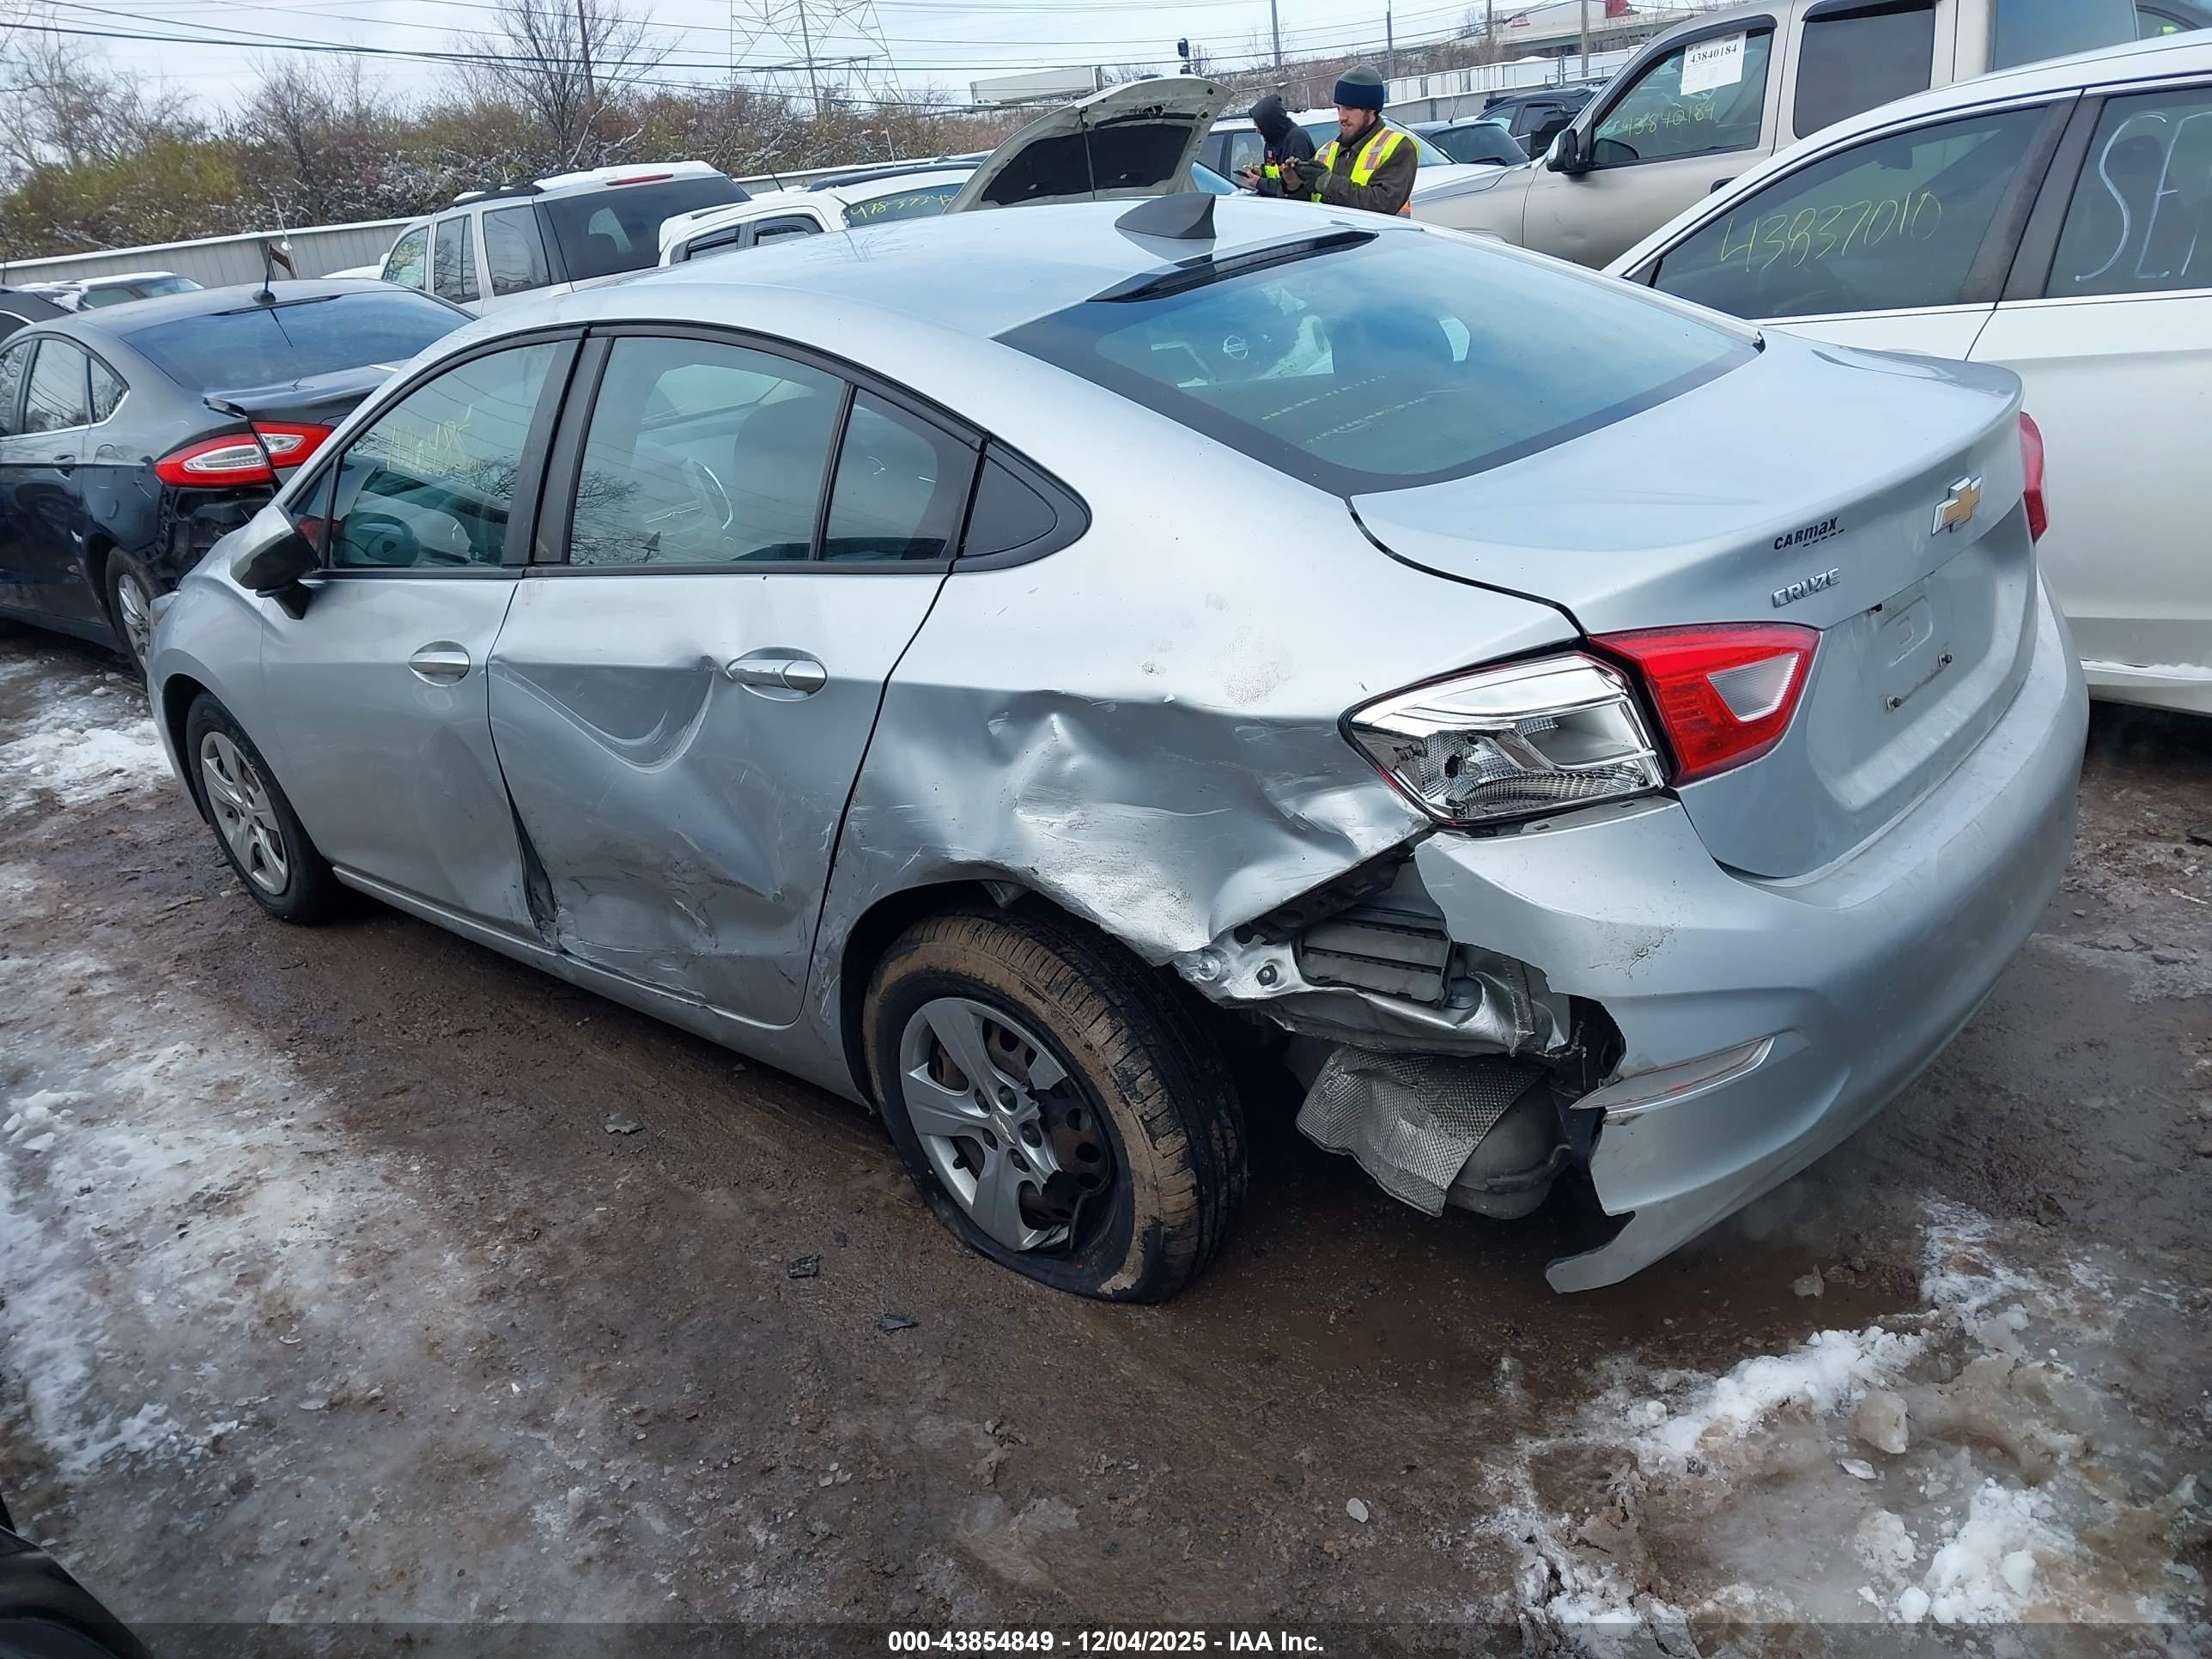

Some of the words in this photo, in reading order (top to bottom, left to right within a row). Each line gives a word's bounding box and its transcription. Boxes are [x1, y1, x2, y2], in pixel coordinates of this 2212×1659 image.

[1689, 43, 1738, 64] 43840184
[1621, 102, 1716, 137] 43840184
[1720, 190, 1942, 273] 43837010
[1771, 566, 1841, 609] CRUZE
